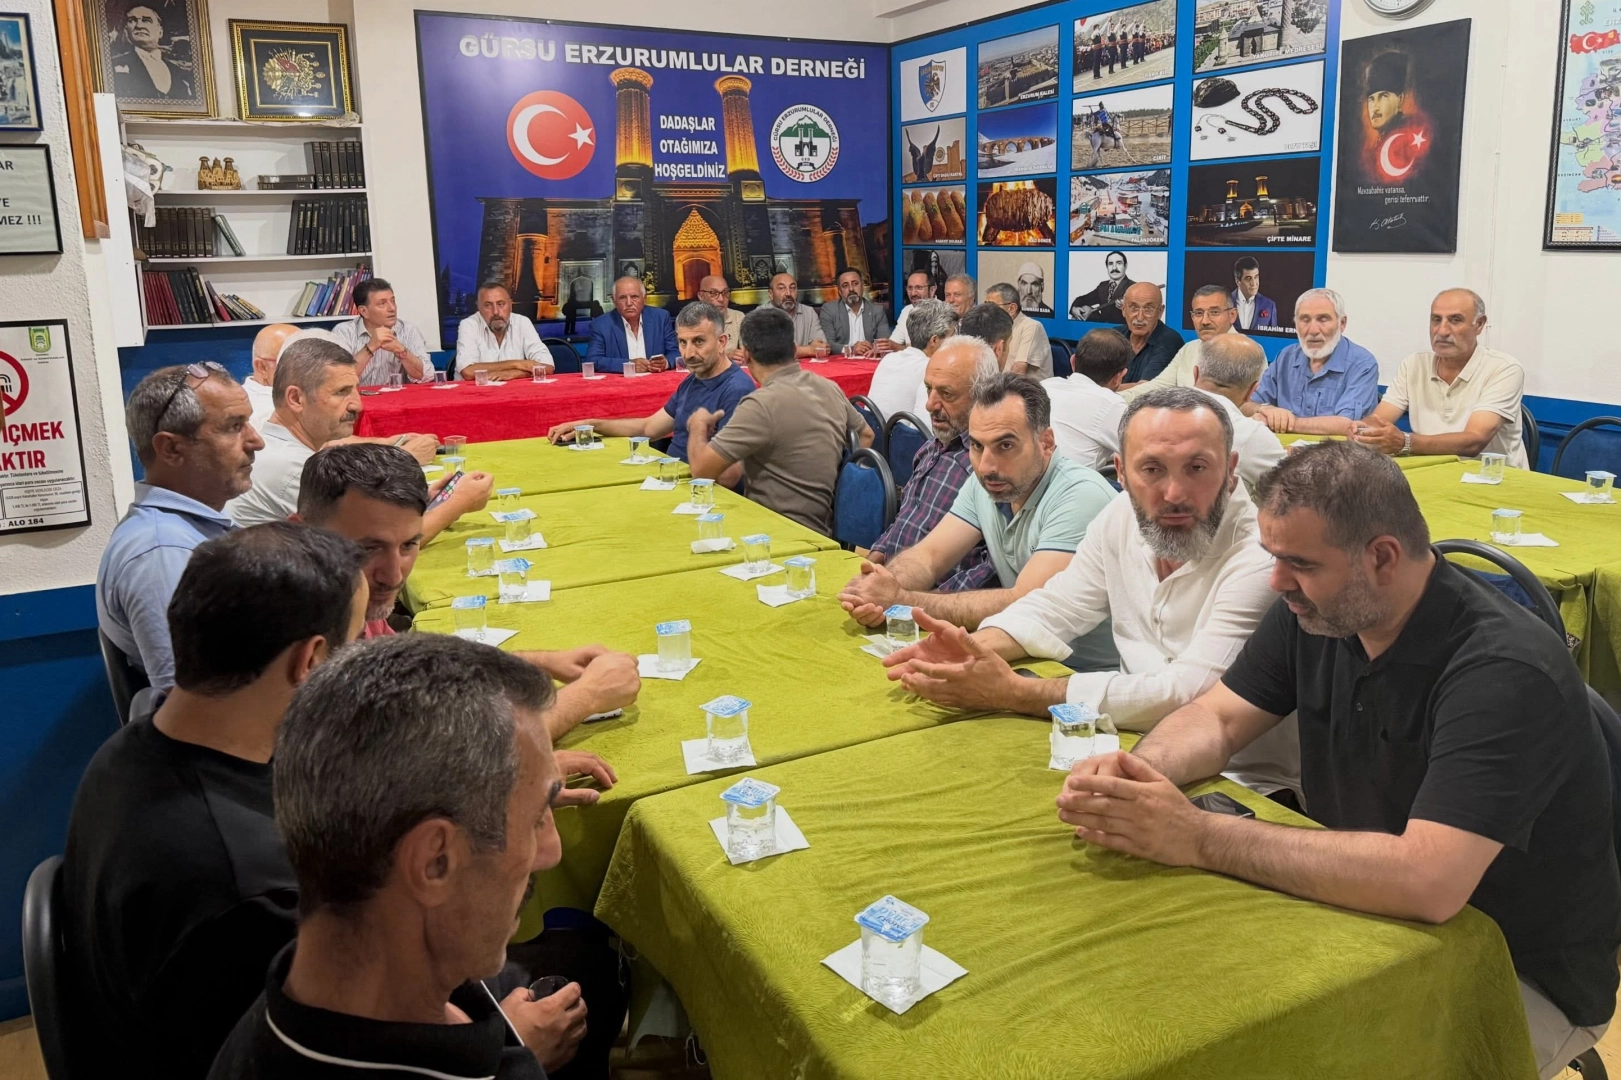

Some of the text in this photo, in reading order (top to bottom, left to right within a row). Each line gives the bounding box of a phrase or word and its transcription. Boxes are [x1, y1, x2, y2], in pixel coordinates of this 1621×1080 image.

[459, 32, 865, 79] GÜRSU ERZURUMLULAR DERNEĞİ
[660, 115, 715, 133] DADAŞLAR
[774, 106, 837, 142] GÜRSU ERZURUMLULAR DERNEĞİ
[660, 137, 718, 154] OTAĞIMIZA
[654, 161, 726, 180] HOŞGELDİNİZ
[27, 215, 41, 225] !!!
[1267, 235, 1285, 243] ÇİFTE
[1258, 324, 1284, 332] İBRAHİM
